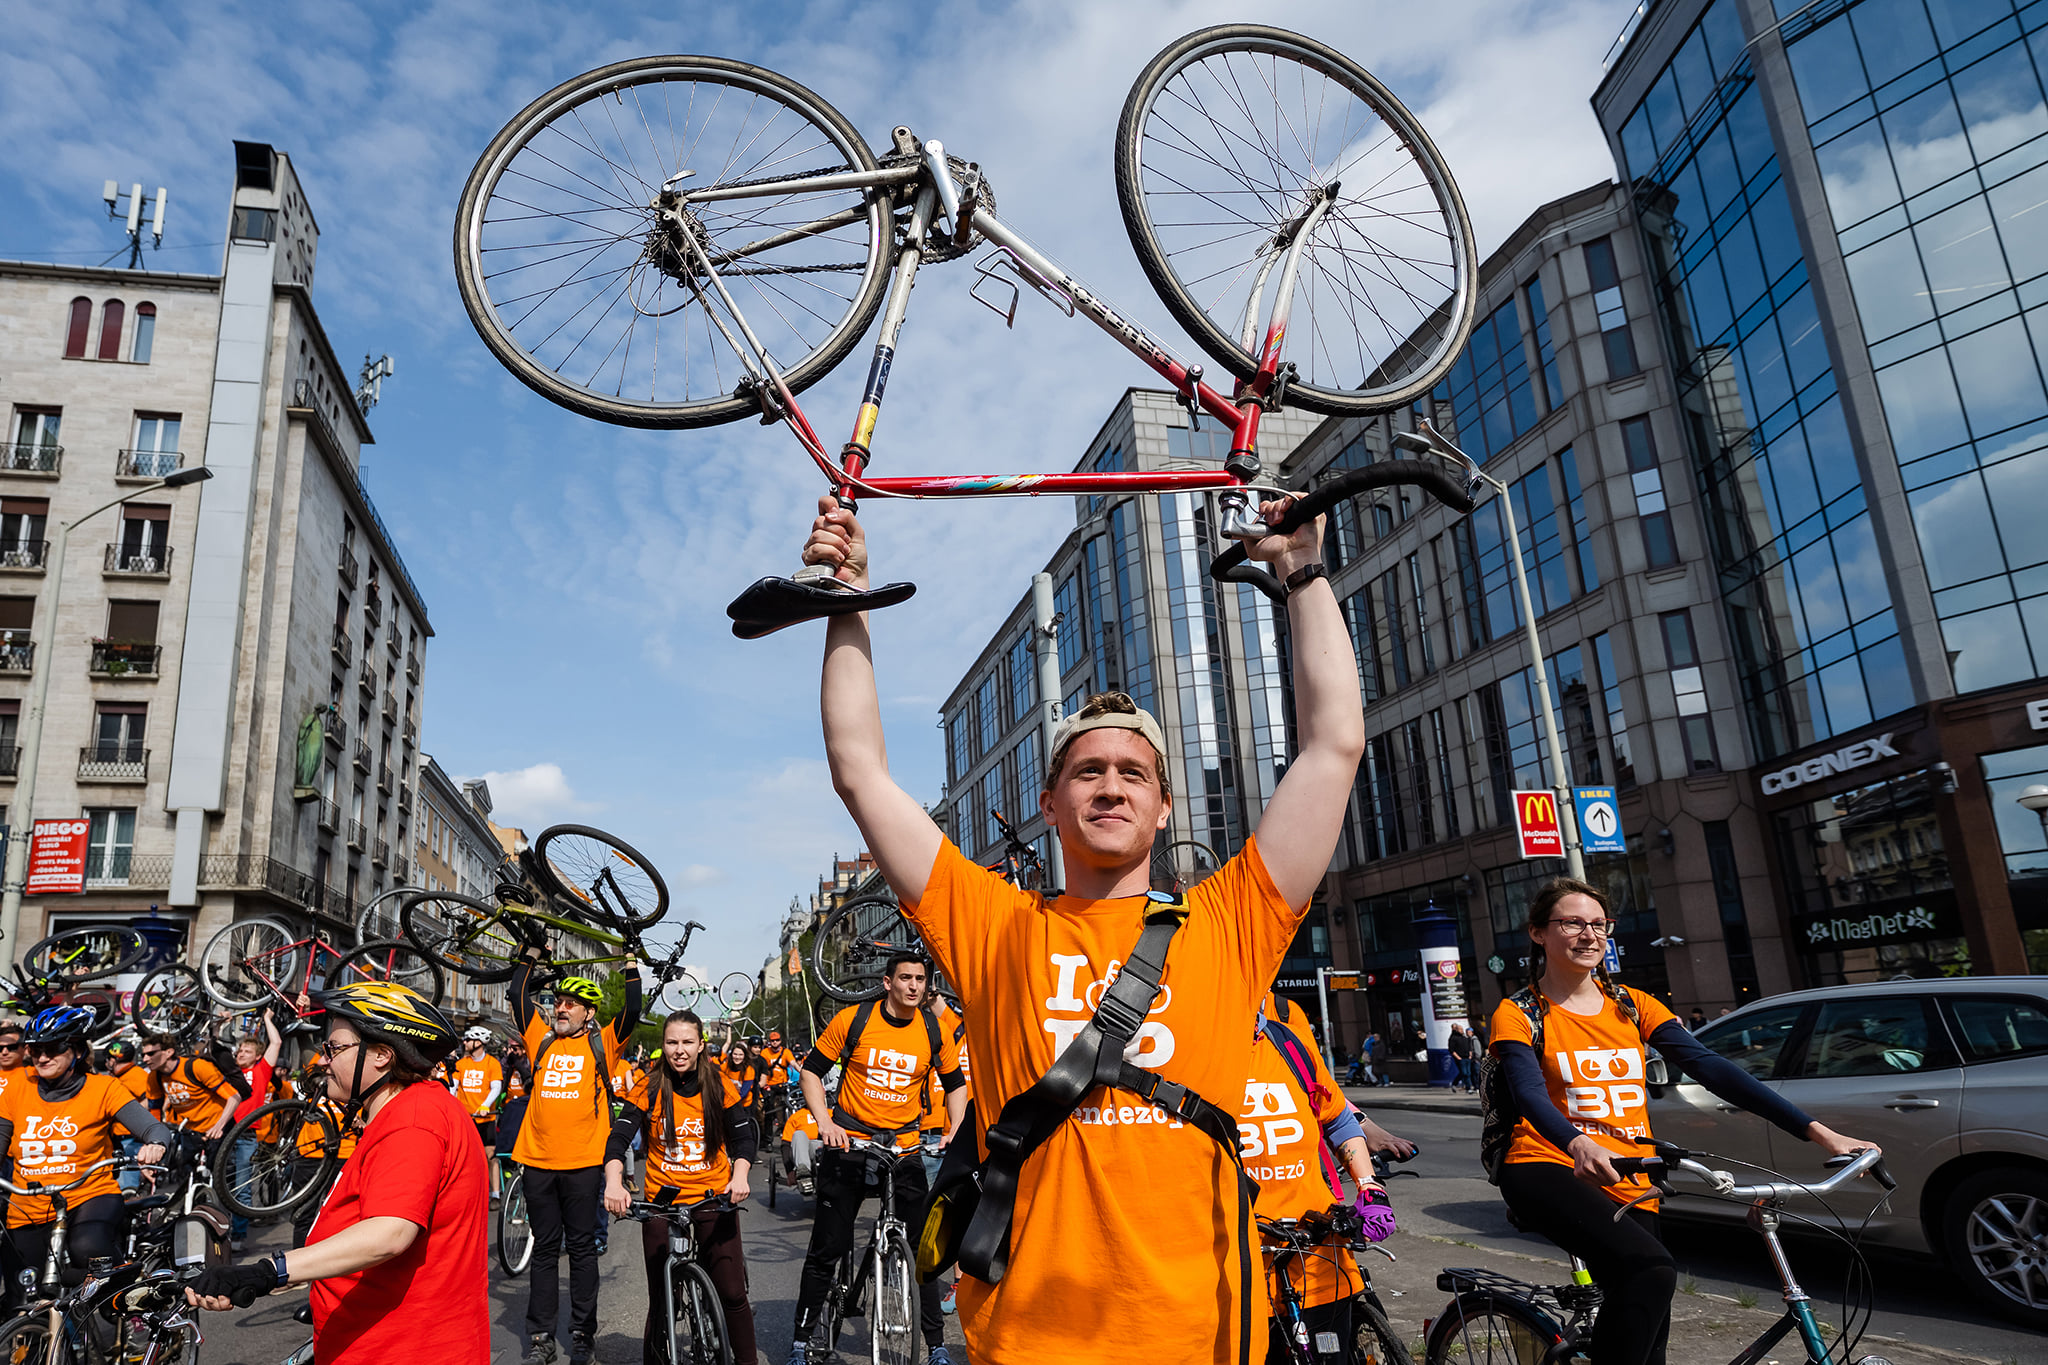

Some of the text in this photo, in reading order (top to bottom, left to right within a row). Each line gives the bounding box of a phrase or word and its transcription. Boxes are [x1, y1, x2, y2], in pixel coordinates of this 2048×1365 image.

[1760, 732, 1901, 796] COGNEX
[1580, 790, 1611, 798] IKEA
[35, 823, 87, 836] DIEGO
[1524, 830, 1559, 838] McDonald's
[1830, 911, 1909, 942] MagNet
[1045, 953, 1088, 1012] I
[1402, 970, 1419, 983] Pizz
[383, 1023, 438, 1041] BALANCE
[543, 1070, 582, 1088] BP
[866, 1068, 911, 1089] BP
[1565, 1084, 1645, 1118] BP
[18, 1140, 77, 1165] BP
[1246, 1160, 1305, 1180] NDEZŐ
